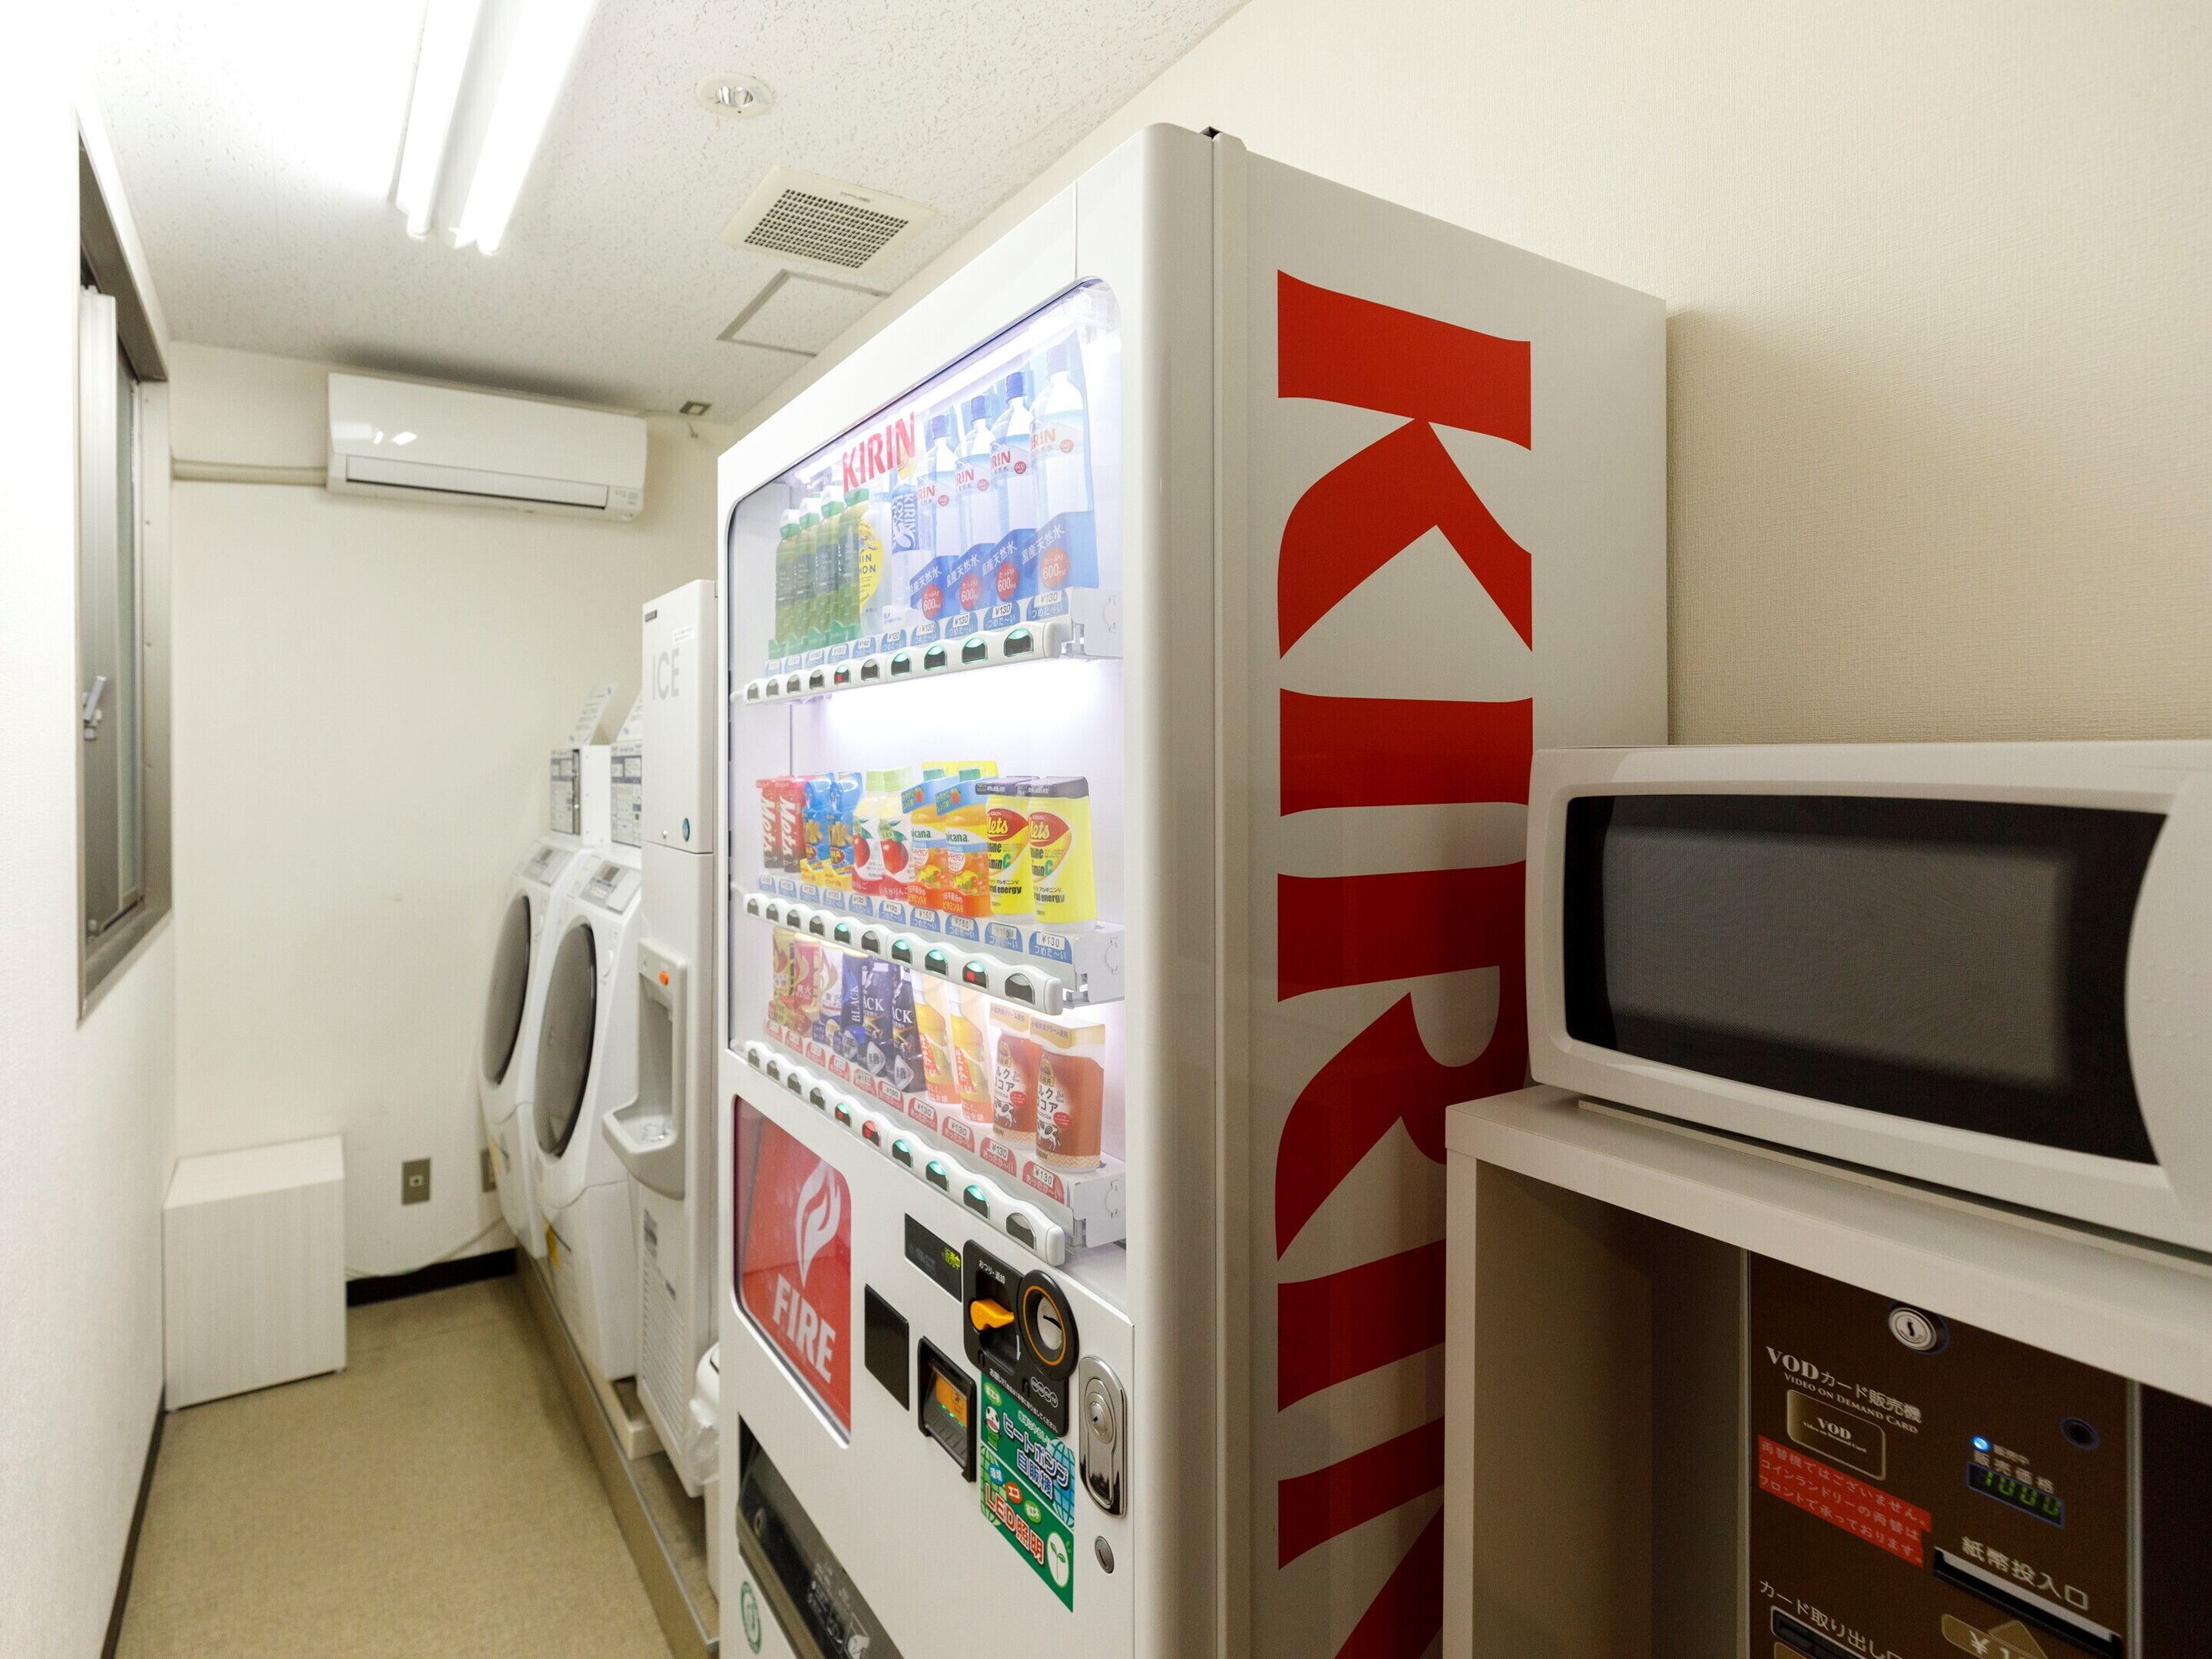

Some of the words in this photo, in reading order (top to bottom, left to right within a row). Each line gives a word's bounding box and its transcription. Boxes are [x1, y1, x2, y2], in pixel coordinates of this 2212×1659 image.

[1031, 428, 1055, 448] RIN
[843, 412, 916, 492] KIRIN
[992, 451, 1011, 469] RIN
[1022, 524, 1065, 565] 国産天然水
[982, 541, 1018, 577] 国産天然水
[946, 553, 981, 588] 国産天然水
[1040, 592, 1058, 604] ¥130
[955, 614, 969, 624] ¥130
[995, 604, 1011, 616] ¥130
[653, 648, 680, 700] ICE
[762, 796, 776, 853] Mets
[780, 796, 796, 856] Mets
[997, 885, 1022, 894] energy
[1041, 892, 1065, 903] energy
[919, 910, 932, 920] ¥150
[955, 918, 969, 929] ¥150
[1041, 935, 1060, 948] ¥130
[1034, 945, 1067, 959] つめた～い
[863, 995, 885, 1012] ACK
[892, 1006, 912, 1024] ACK
[995, 1078, 1015, 1092] コア
[996, 1067, 1020, 1083] ルクと
[1039, 1084, 1065, 1104] ルクと
[916, 1101, 932, 1117] ¥130
[1038, 1097, 1058, 1113] コア
[951, 1121, 968, 1137] ¥130
[991, 1143, 1008, 1158] ¥130
[1035, 1167, 1053, 1185] ¥130
[979, 1260, 1006, 1284] おつり・返却
[773, 1273, 836, 1383] FIRE
[1766, 1346, 1922, 1424] VODカード販売機
[1784, 1373, 1816, 1392] VIDEO
[1818, 1387, 1834, 1399] ON
[1836, 1394, 1884, 1420] DEMAND
[1886, 1415, 1919, 1434] CARD
[1816, 1416, 1852, 1440] VOD
[1003, 1412, 1068, 1487] ヒートポンプ
[1016, 1448, 1053, 1500] 自販機
[1974, 1450, 2055, 1494] 販売価格
[1008, 1485, 1021, 1500] エコ
[1763, 1441, 1926, 1527] 両替機ではございません。
[1985, 1471, 2061, 1517] 1000
[1762, 1459, 1919, 1542] コインランドリーの両替は
[985, 1482, 1045, 1565] LED照明
[1760, 1474, 1923, 1565] フロントで承っております。
[1962, 1536, 2088, 1611] 紙幣投入口
